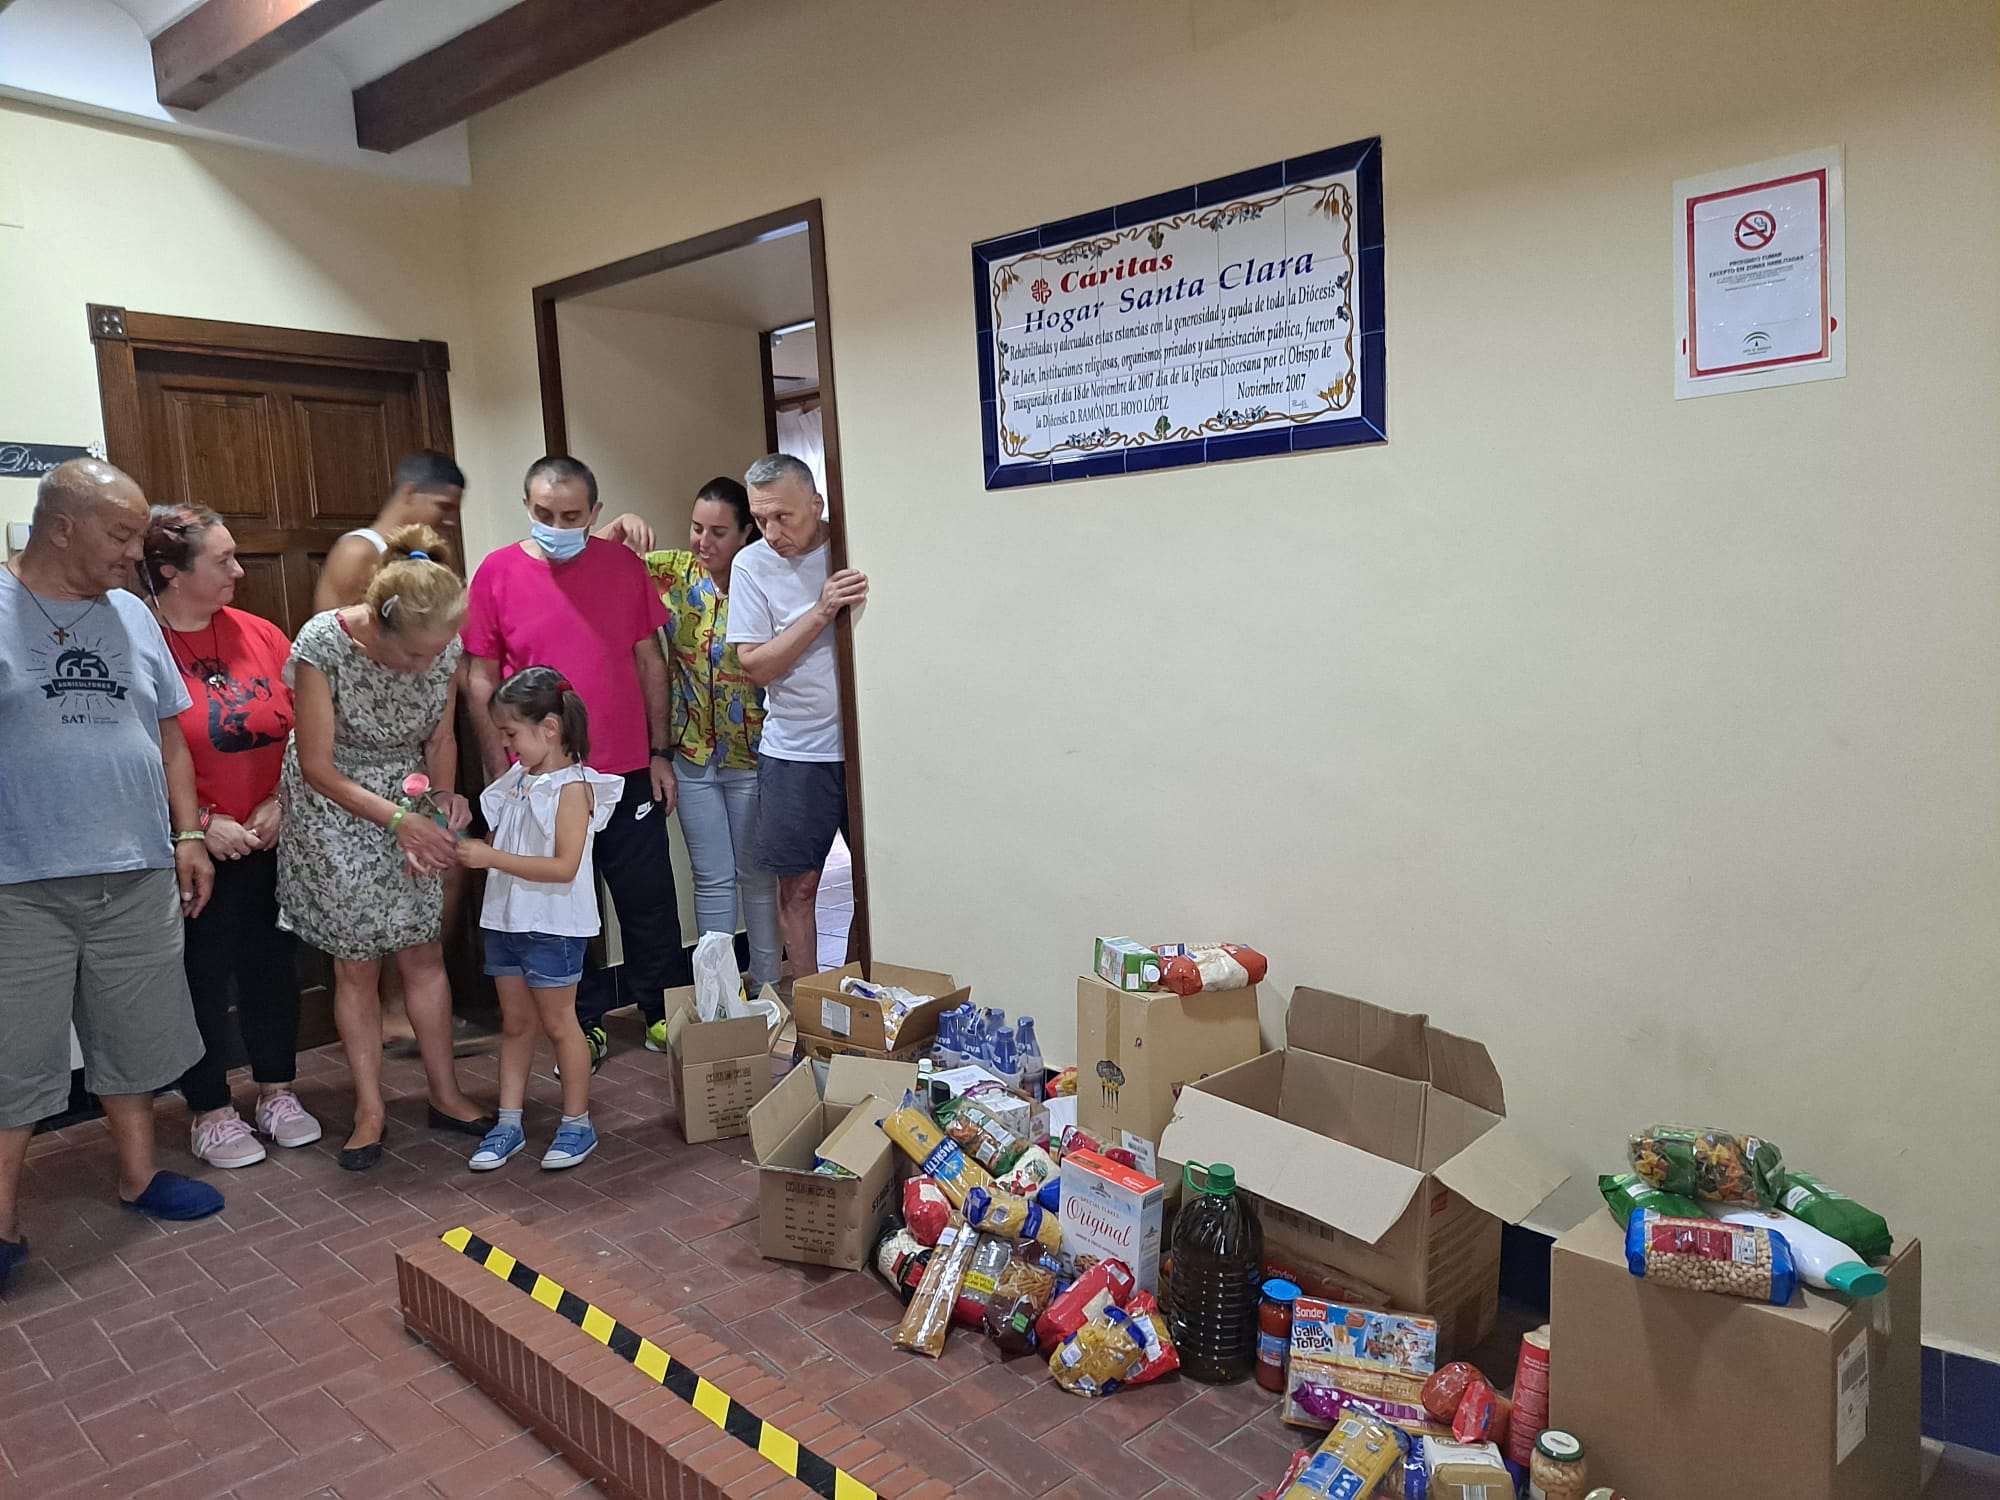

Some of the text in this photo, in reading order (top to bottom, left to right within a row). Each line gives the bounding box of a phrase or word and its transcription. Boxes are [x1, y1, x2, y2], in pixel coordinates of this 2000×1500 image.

[1024, 252, 1314, 334] Hogar Santa Clara
[1060, 254, 1173, 293] Cáritas
[1095, 329, 1113, 344] estas
[1115, 321, 1149, 340] estancias
[1150, 322, 1163, 335] con
[1165, 314, 1173, 328] la
[1174, 304, 1220, 336] generosidad
[1220, 309, 1227, 326] y
[1228, 295, 1253, 323] ayuda
[1255, 298, 1264, 313] de
[1266, 291, 1285, 310] toda
[1288, 288, 1296, 305] la
[1299, 281, 1336, 304] Diócesis
[1012, 369, 1019, 386] de
[1039, 362, 1083, 382] Instituciones
[1121, 347, 1162, 371] organismos
[1164, 338, 1196, 365] privados
[1198, 342, 1203, 358] y
[1205, 326, 1265, 349] administración
[1268, 320, 1303, 347] pública,
[1304, 316, 1335, 340] fueron
[1054, 388, 1060, 405] el
[1091, 378, 1127, 399] Noviembre
[1128, 376, 1136, 391] de
[1138, 373, 1153, 391] 2007
[1170, 368, 1179, 384] de
[1181, 366, 1189, 383] la
[1191, 361, 1218, 387] Iglesia
[1221, 357, 1261, 377] Diocesana
[1263, 355, 1277, 374] por
[1279, 351, 1287, 365] el
[1288, 344, 1319, 368] Obispo
[1321, 341, 1331, 359] de
[1237, 374, 1306, 400] Noviembre 2007
[1035, 415, 1041, 429] la
[1105, 404, 1120, 418] DEL
[1121, 400, 1143, 415] HOYO
[1144, 393, 1169, 413] LÓPEZ
[60, 658, 100, 677] 65
[61, 714, 86, 724] SAT
[1066, 1196, 1132, 1247] Original
[1294, 1325, 1323, 1337] Galle
